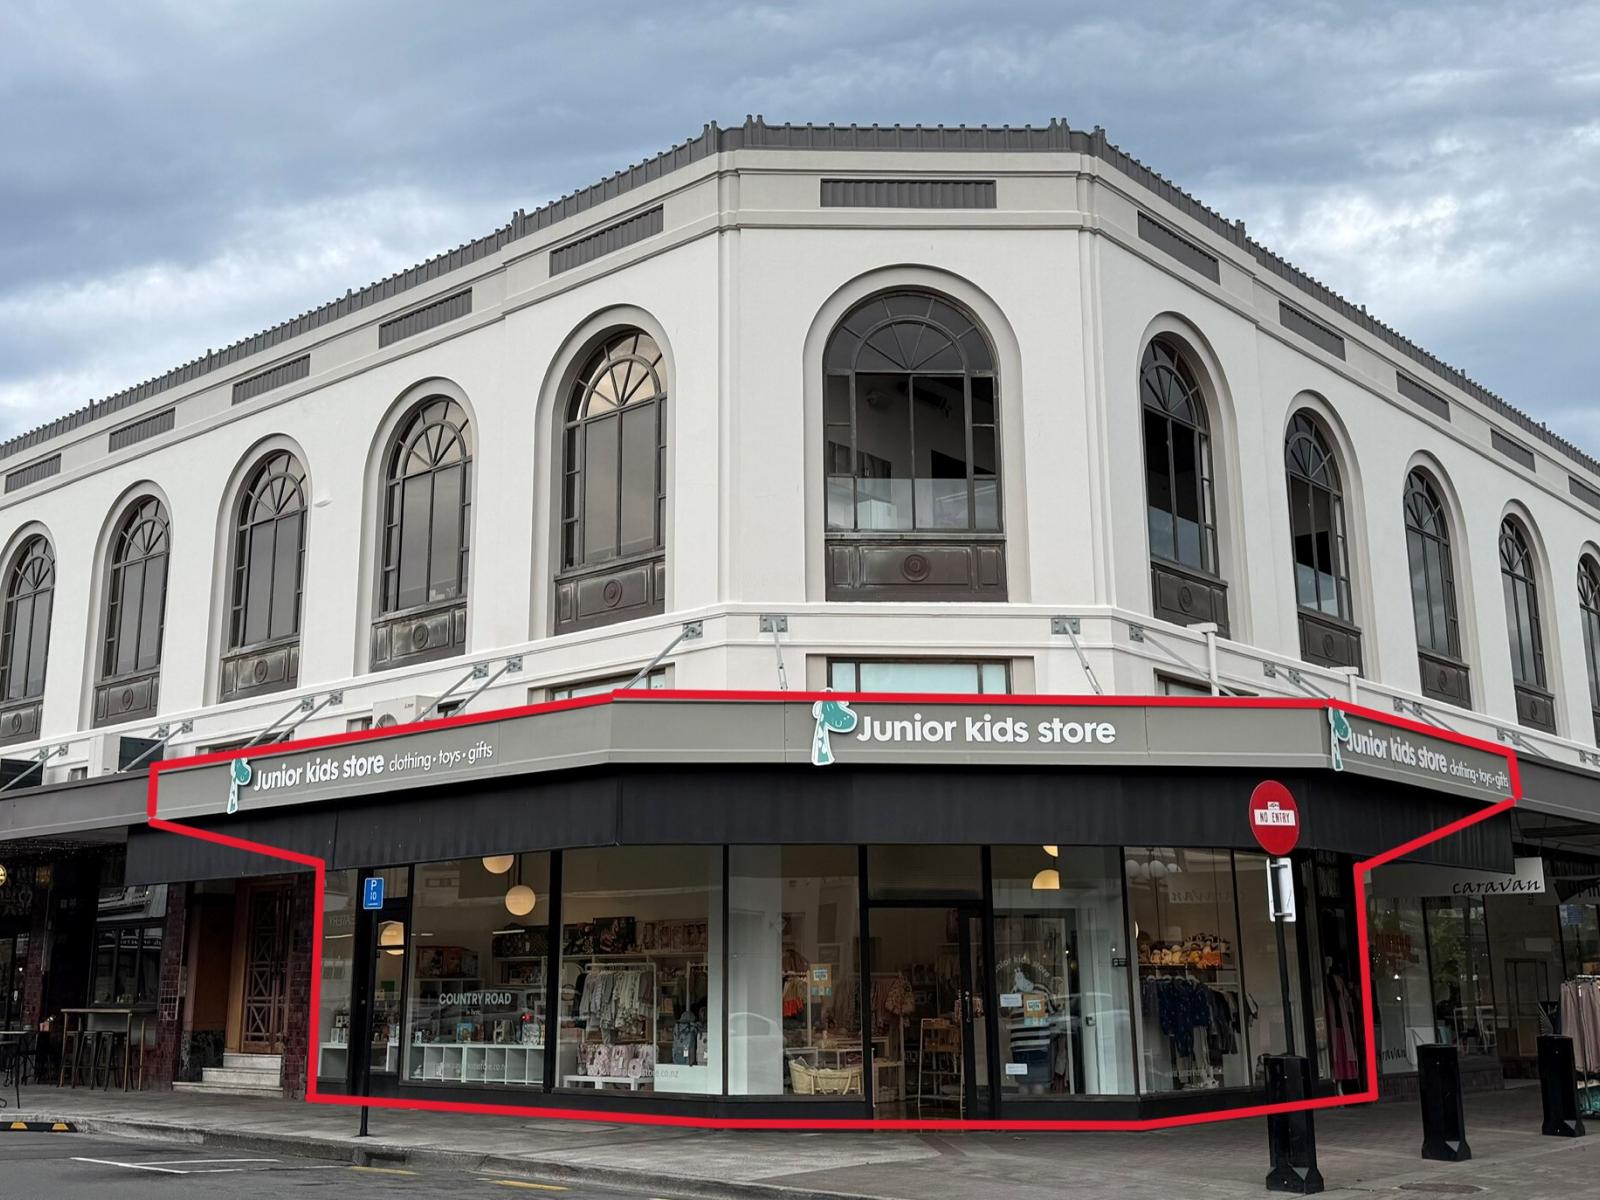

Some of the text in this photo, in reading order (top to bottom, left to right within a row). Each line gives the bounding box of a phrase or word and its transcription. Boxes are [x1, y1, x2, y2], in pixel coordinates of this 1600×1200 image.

[856, 712, 1116, 744] Junior kids store
[1346, 728, 1388, 760] Junior
[1389, 735, 1417, 767] kids
[1417, 746, 1448, 774] store
[1449, 759, 1477, 784] clothing
[253, 740, 493, 792] Junior kids store clothing toys gifts
[1259, 812, 1290, 823] NO ENTRY
[370, 879, 378, 891] P
[1452, 878, 1541, 895] caravan
[439, 992, 512, 1005] COUNTRY ROAD
